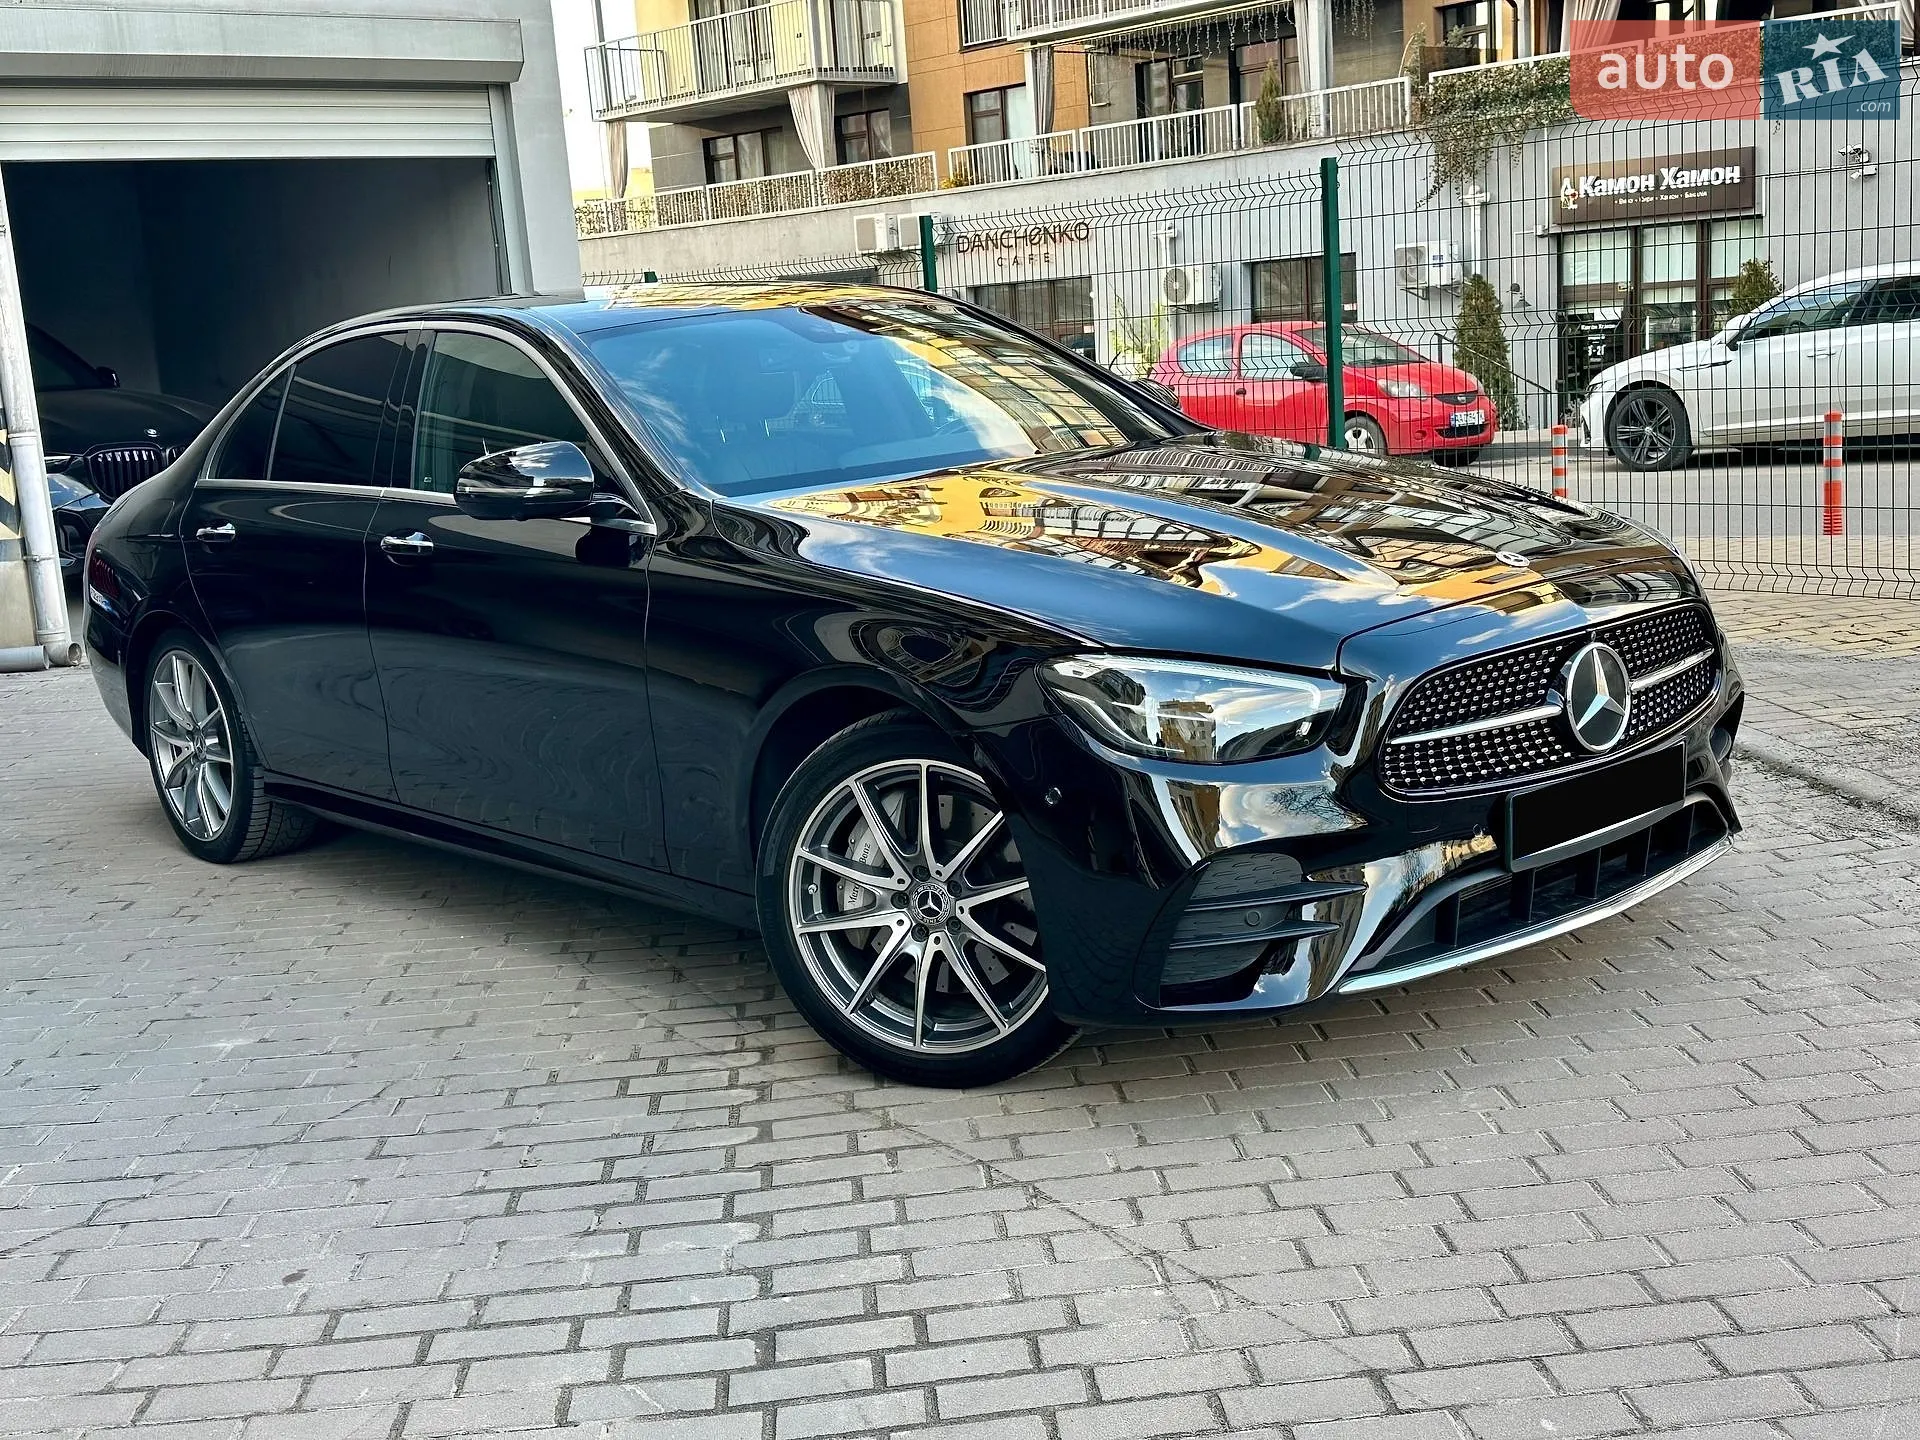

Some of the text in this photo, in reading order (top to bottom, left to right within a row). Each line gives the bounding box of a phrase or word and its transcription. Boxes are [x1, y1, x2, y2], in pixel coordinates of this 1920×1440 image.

[1578, 165, 1741, 198] Камон Хамон
[996, 253, 1050, 267] CAFE
